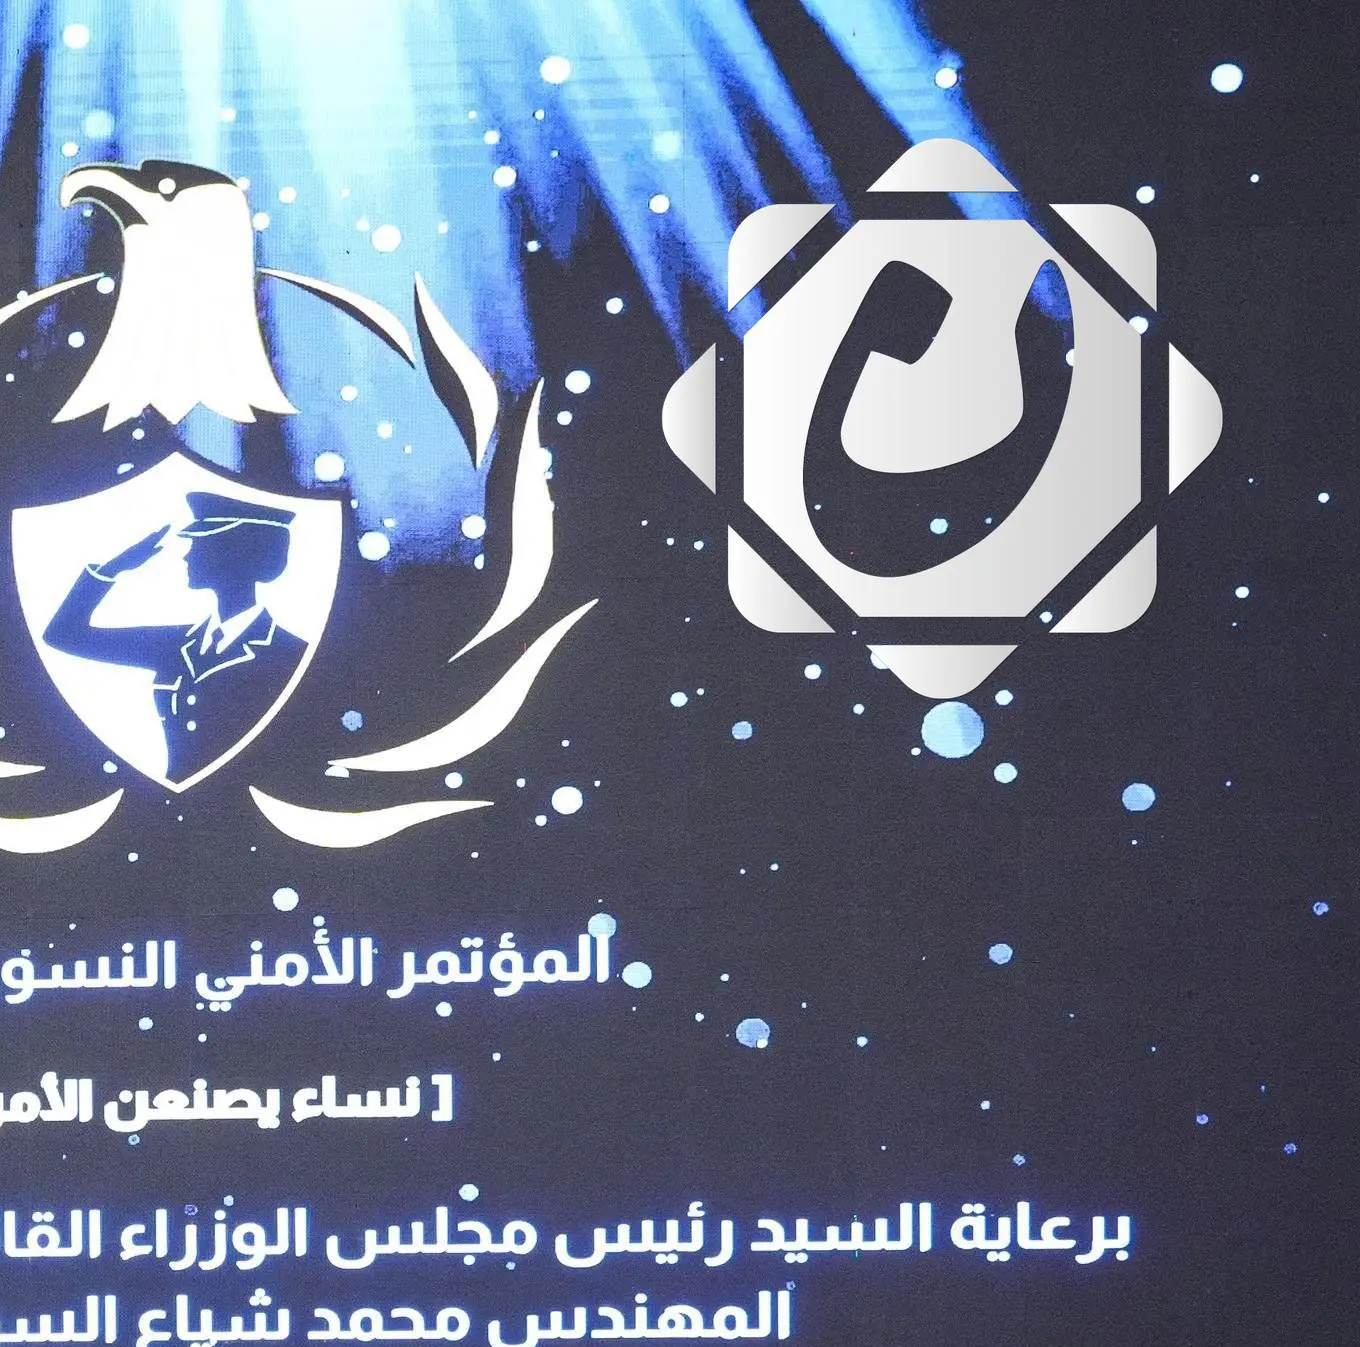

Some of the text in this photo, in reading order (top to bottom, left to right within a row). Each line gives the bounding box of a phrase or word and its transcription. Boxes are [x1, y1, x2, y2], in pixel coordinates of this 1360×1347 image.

[195, 928, 379, 1013] الأمني
[386, 931, 611, 999] المؤتمر
[103, 1078, 280, 1133] يصنعن
[291, 1075, 421, 1123] نساء
[119, 1207, 307, 1271] الوزراء
[326, 1205, 538, 1270] مجلس
[554, 1201, 734, 1268] رئيس
[750, 1202, 932, 1264] السيد
[950, 1201, 1131, 1265] برعاية
[307, 1306, 471, 1342] محمد
